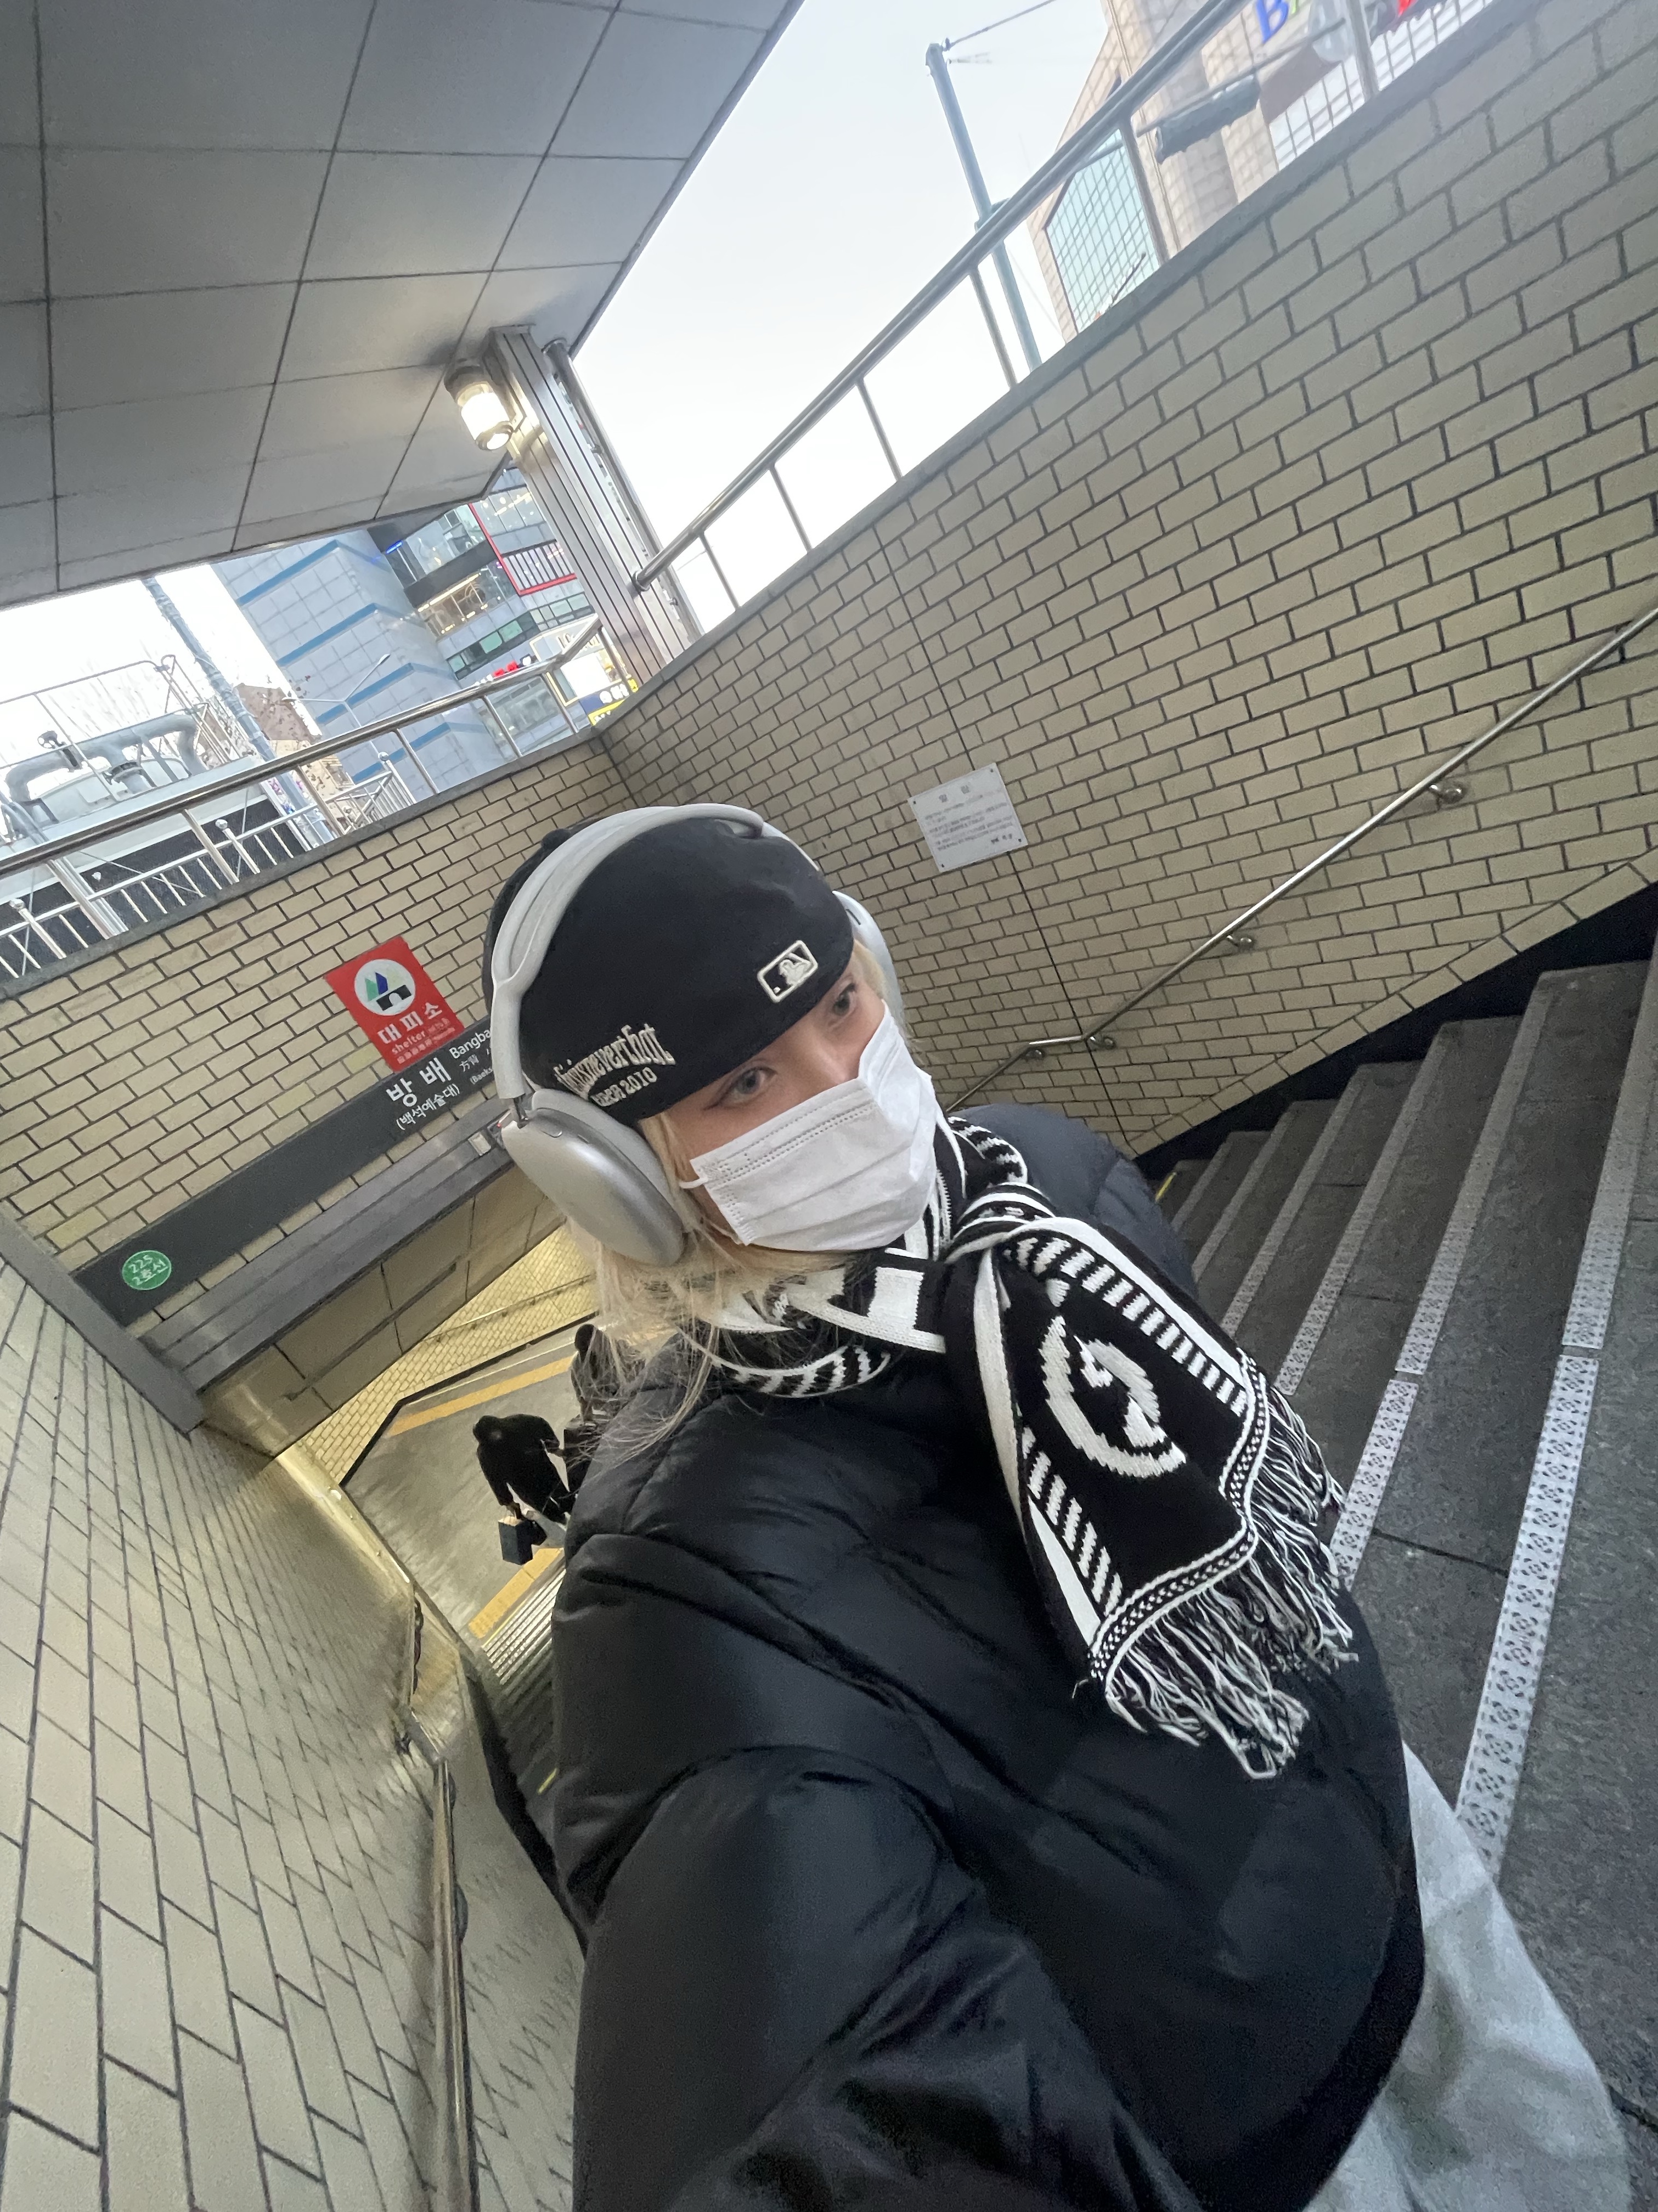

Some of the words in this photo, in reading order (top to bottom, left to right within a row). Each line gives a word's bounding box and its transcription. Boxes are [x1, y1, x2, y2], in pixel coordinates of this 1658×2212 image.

[377, 1002, 442, 1044] 대피소
[392, 1031, 426, 1055] shelter
[449, 1028, 492, 1059] Bangba
[386, 1057, 452, 1107] 방배
[470, 1067, 493, 1085] (Baeks
[619, 1067, 657, 1095] 2010
[396, 1084, 460, 1130] (백석예술대)
[128, 1255, 153, 1273] 225
